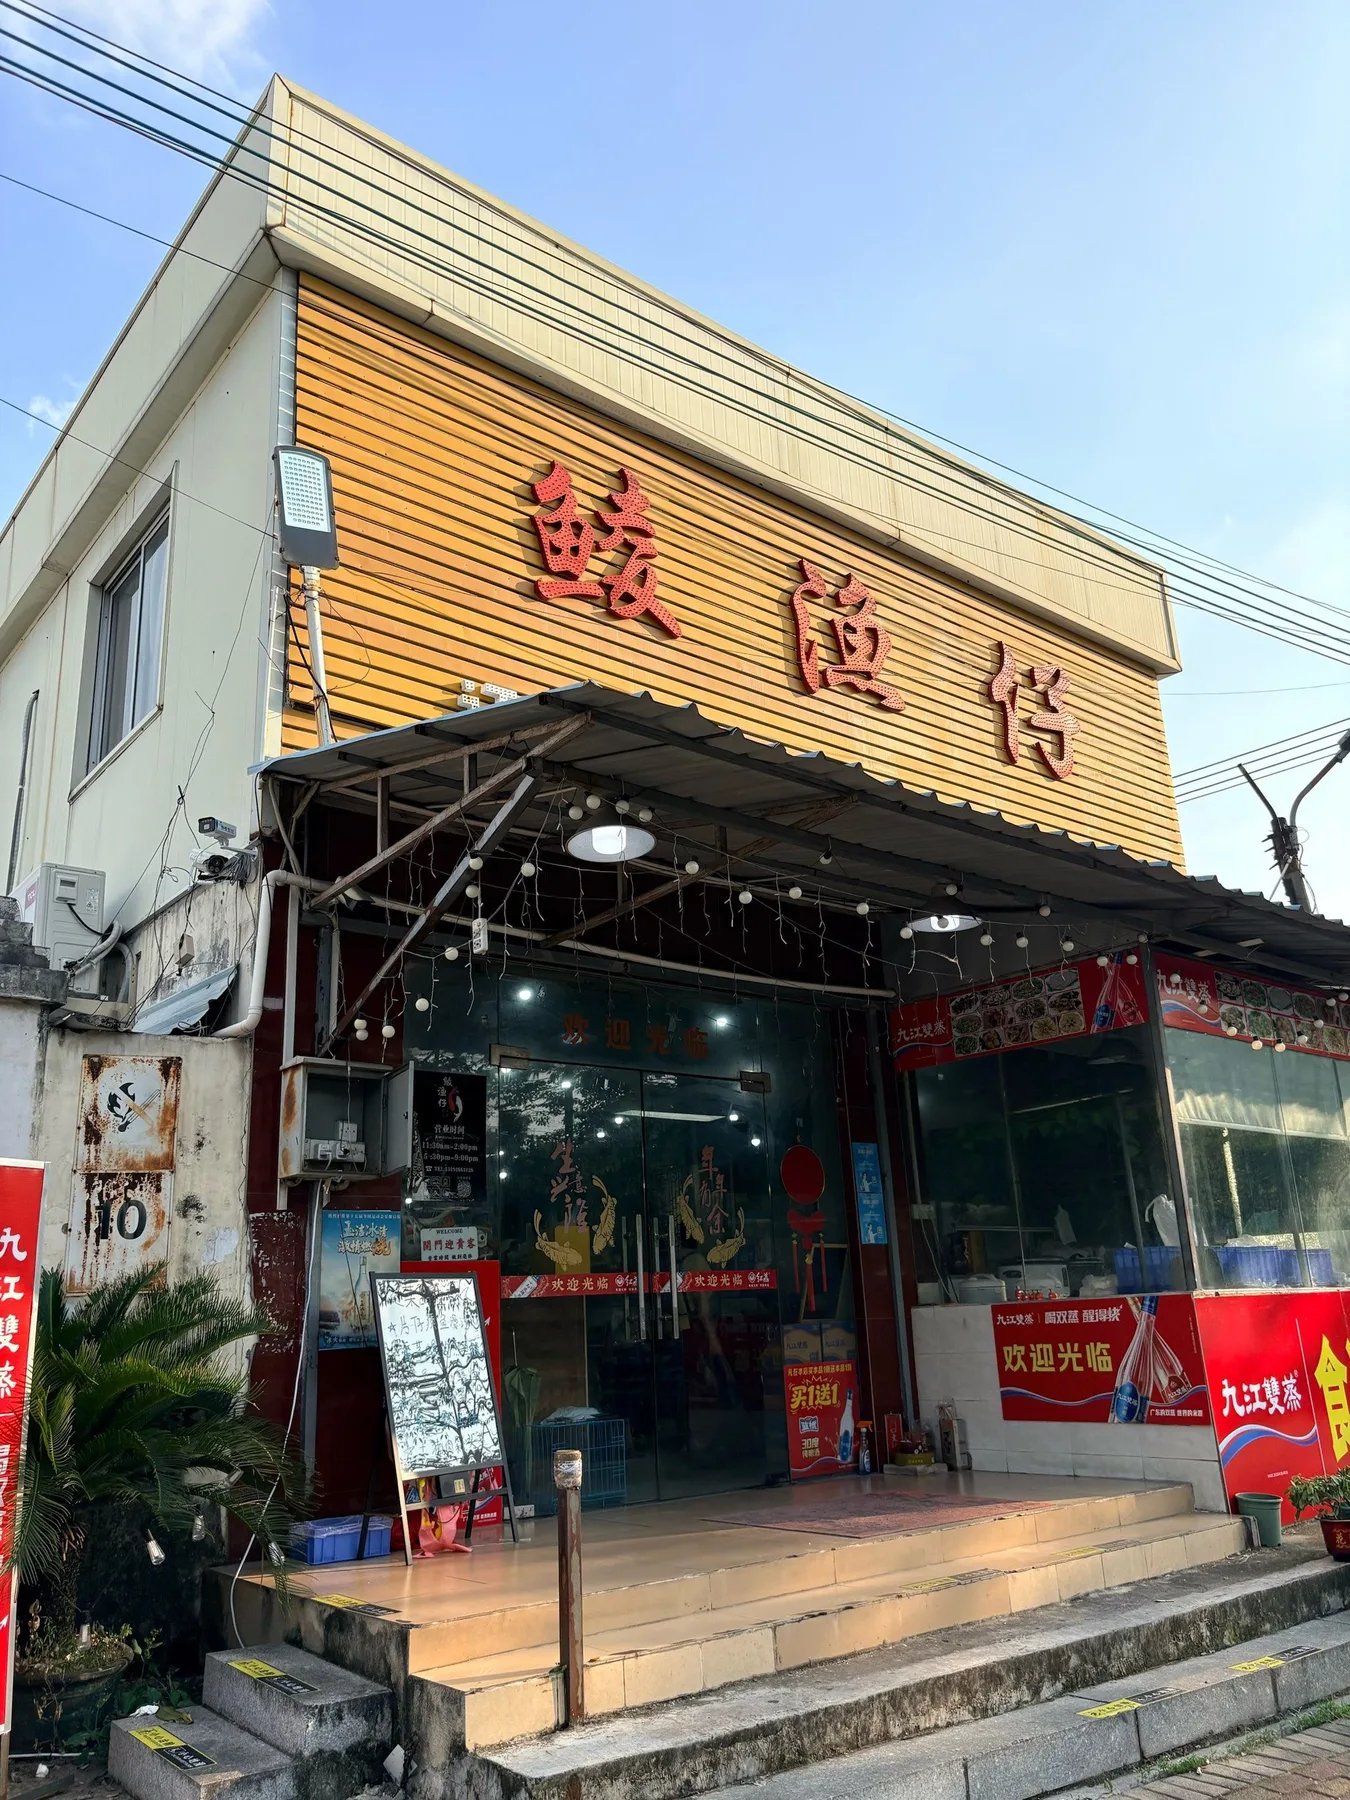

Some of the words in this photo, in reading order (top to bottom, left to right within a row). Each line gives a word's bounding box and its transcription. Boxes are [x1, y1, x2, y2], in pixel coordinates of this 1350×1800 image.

[561, 1010, 709, 1060] 欢迎光临
[434, 1124, 465, 1135] 营业时间
[96, 1199, 147, 1241] 10
[551, 1276, 610, 1293] 欢迎光临
[694, 1273, 744, 1289] 欢迎光临
[1045, 1310, 1080, 1325] 喝双蒸
[1003, 1341, 1114, 1373] 欢迎光临
[790, 1382, 840, 1411] 买1送1
